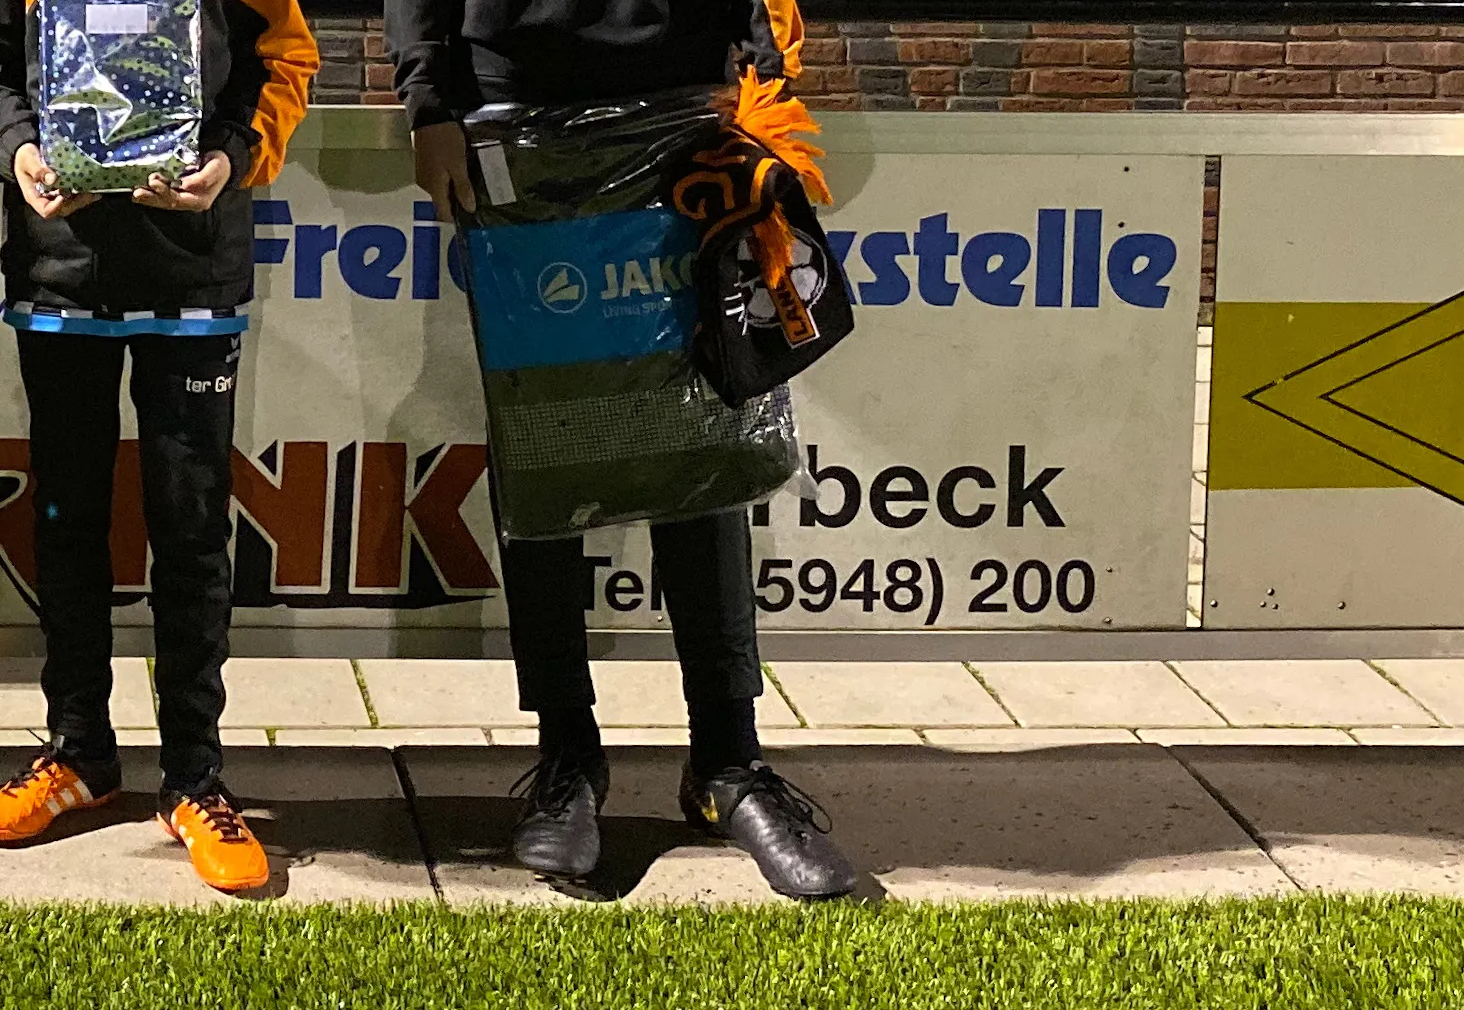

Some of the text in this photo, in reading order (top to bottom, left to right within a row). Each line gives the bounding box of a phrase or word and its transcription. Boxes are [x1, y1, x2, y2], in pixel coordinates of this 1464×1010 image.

[186, 375, 236, 393] ter Gr
[752, 444, 1067, 530] beck
[754, 557, 945, 626] 5948)
[968, 558, 1095, 614] 200
